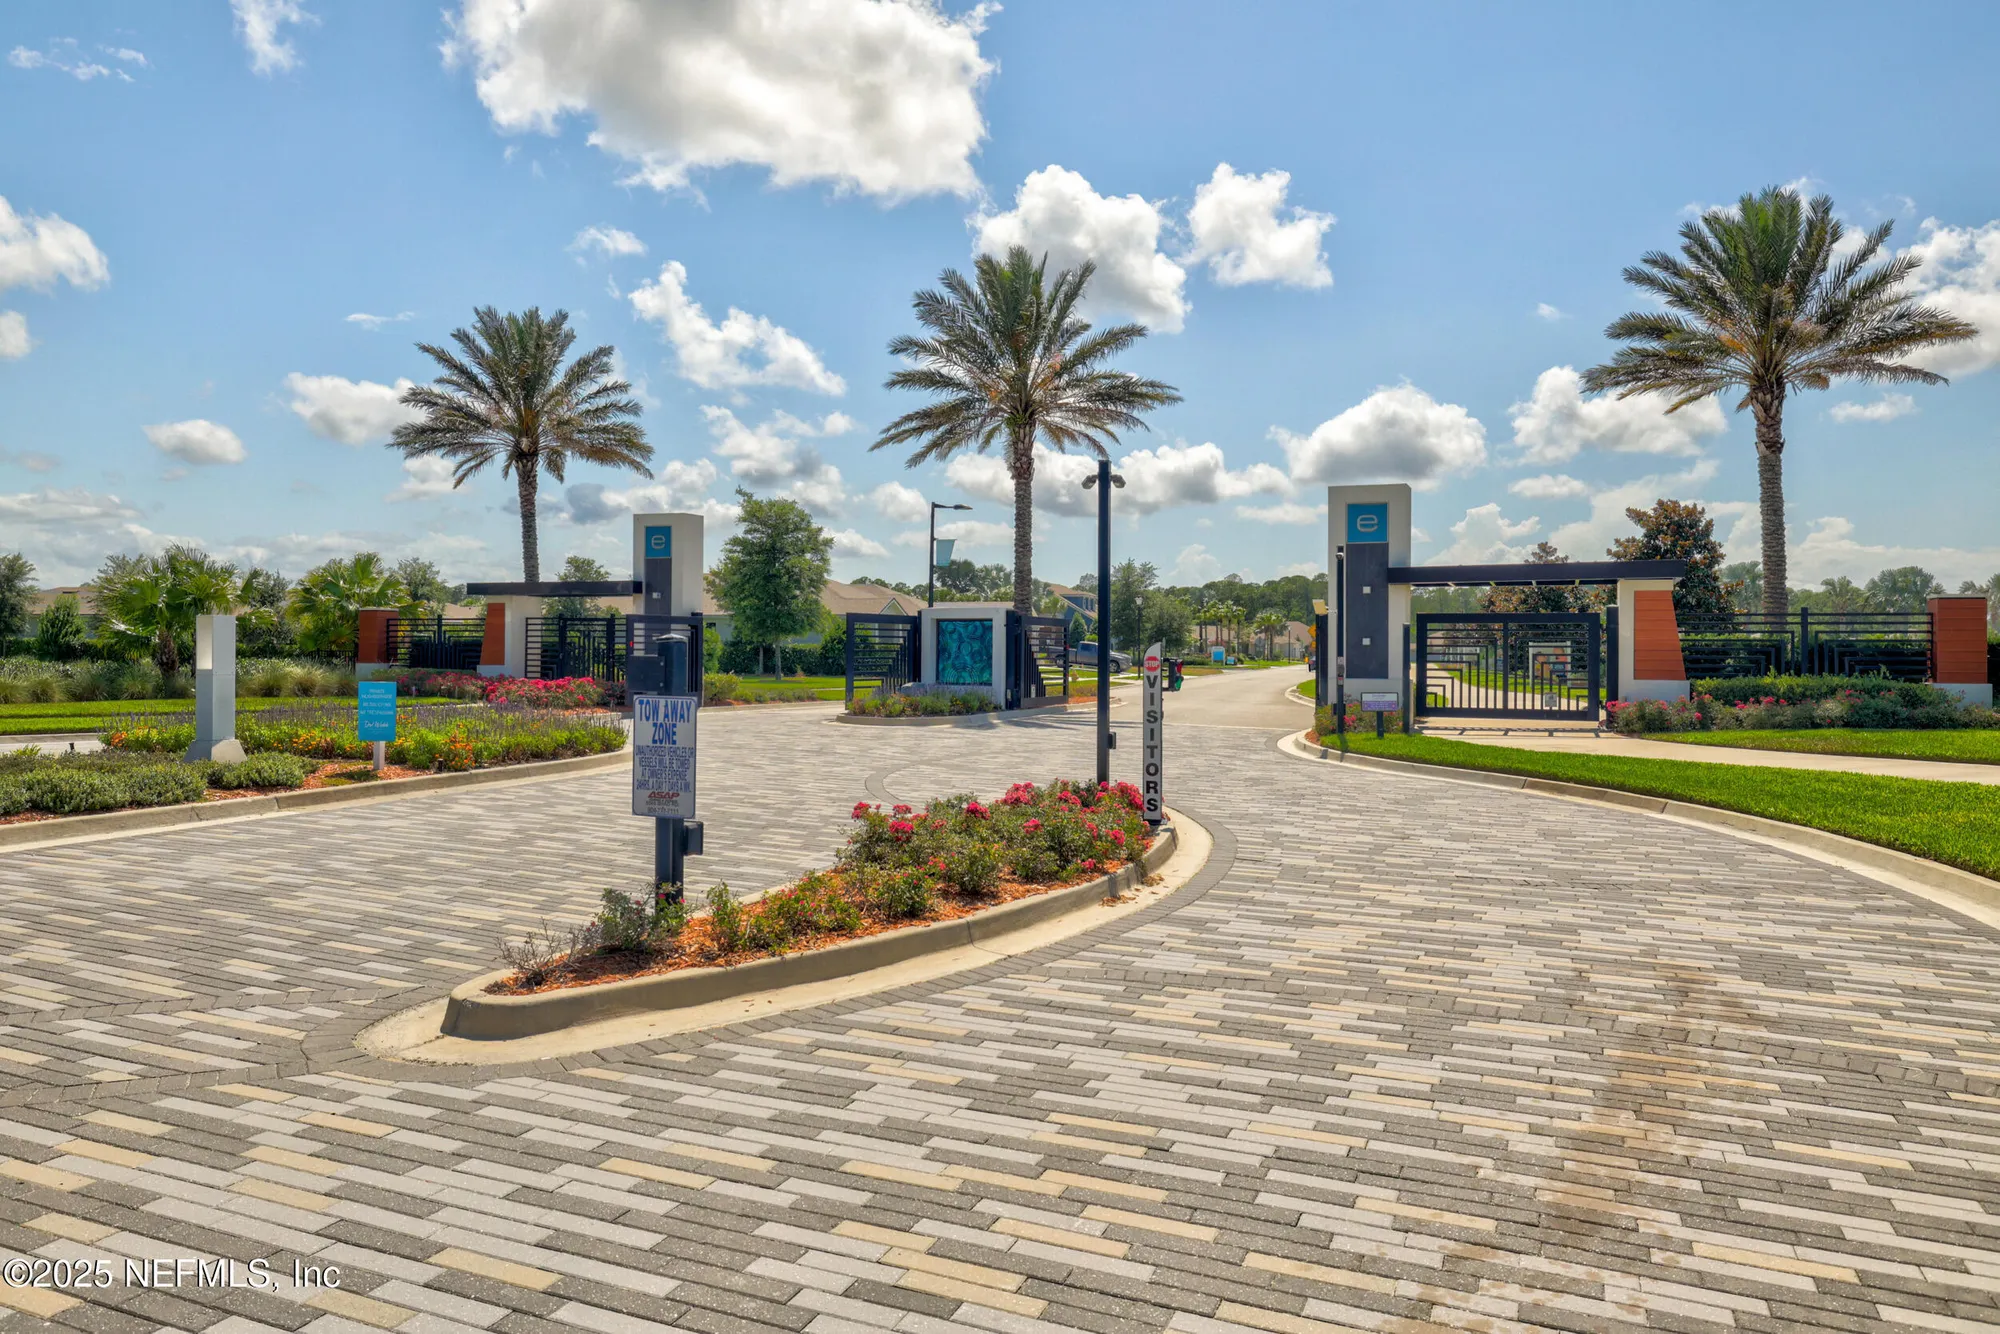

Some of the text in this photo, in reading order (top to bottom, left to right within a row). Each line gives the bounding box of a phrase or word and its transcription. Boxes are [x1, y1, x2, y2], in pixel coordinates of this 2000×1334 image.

[1357, 514, 1378, 532] e
[651, 535, 666, 549] e
[1144, 660, 1160, 668] STOP
[638, 699, 692, 723] TOW AWAY
[651, 722, 677, 745] ZONE
[1145, 675, 1159, 812] VISITORS
[635, 745, 694, 758] UNAUTHORIZED VEHICLES OR
[639, 757, 690, 769] VESSELS WILL BE TOWED
[648, 791, 680, 799] ASAP
